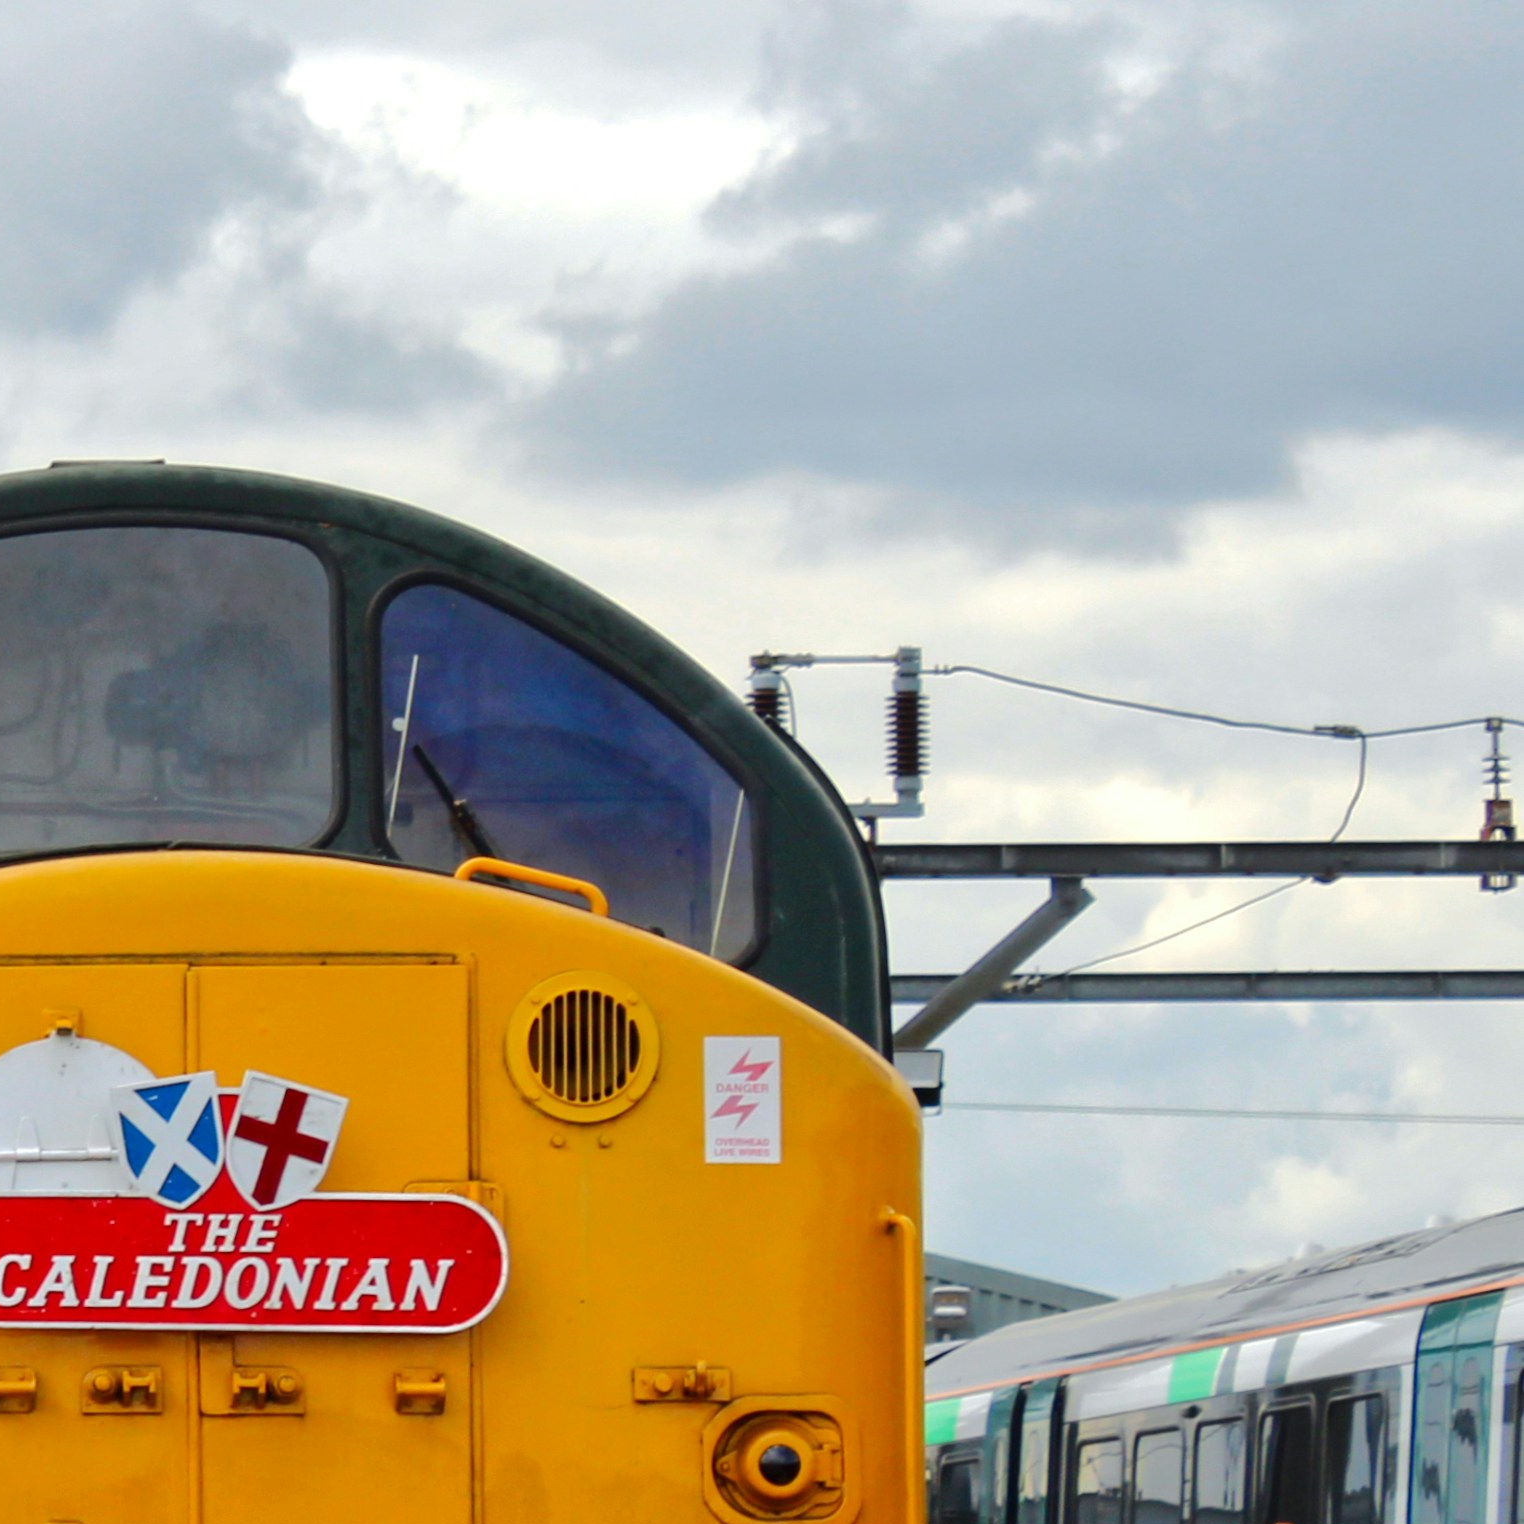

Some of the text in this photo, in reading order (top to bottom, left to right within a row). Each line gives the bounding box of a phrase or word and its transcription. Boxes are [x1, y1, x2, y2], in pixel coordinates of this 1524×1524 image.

[716, 1083, 769, 1093] DANGER
[715, 1138, 770, 1147] OVERHEAD
[714, 1148, 770, 1157] LIVE WIRES
[163, 1213, 282, 1253] THE
